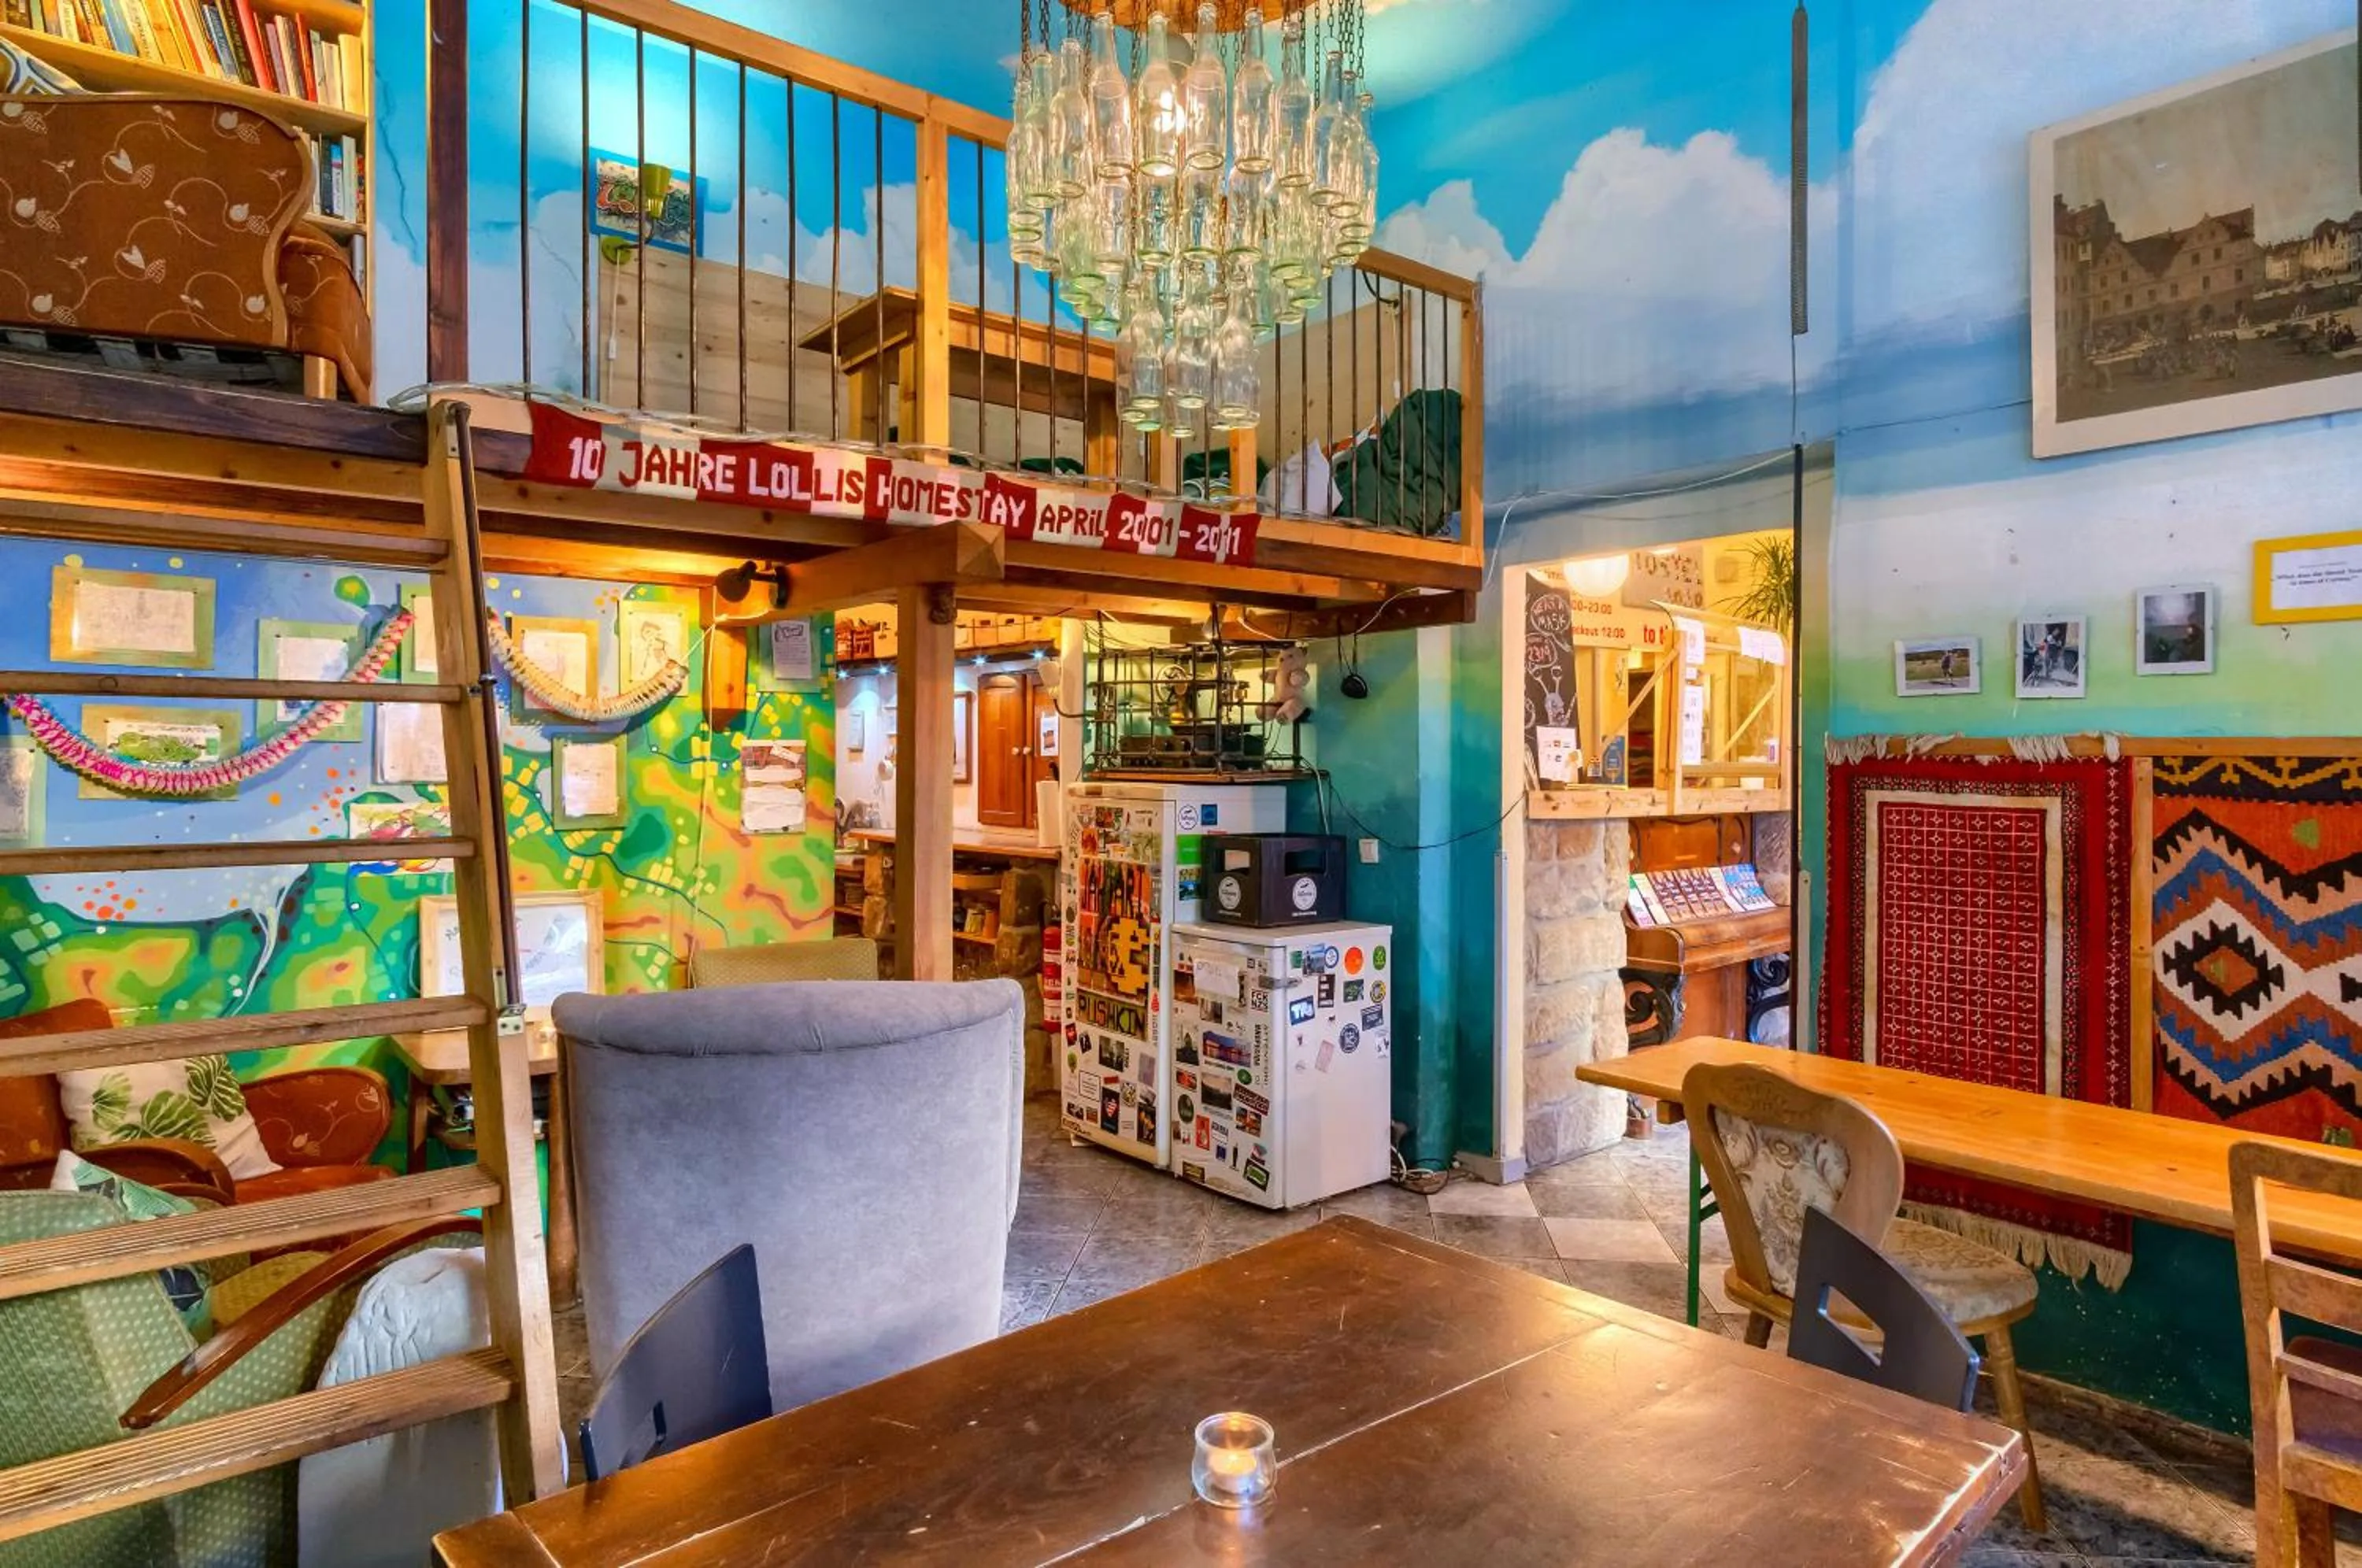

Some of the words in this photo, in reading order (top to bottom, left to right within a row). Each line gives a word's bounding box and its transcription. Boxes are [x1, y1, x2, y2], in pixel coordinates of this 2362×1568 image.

[568, 436, 602, 479] 10
[618, 441, 736, 493] JAHRE
[748, 456, 864, 504] LOLLIS
[876, 474, 1025, 527] HOMESTAY
[1117, 510, 1173, 545] 2001
[1194, 523, 1241, 555] 2011
[1077, 995, 1146, 1041] PUSHKIN
